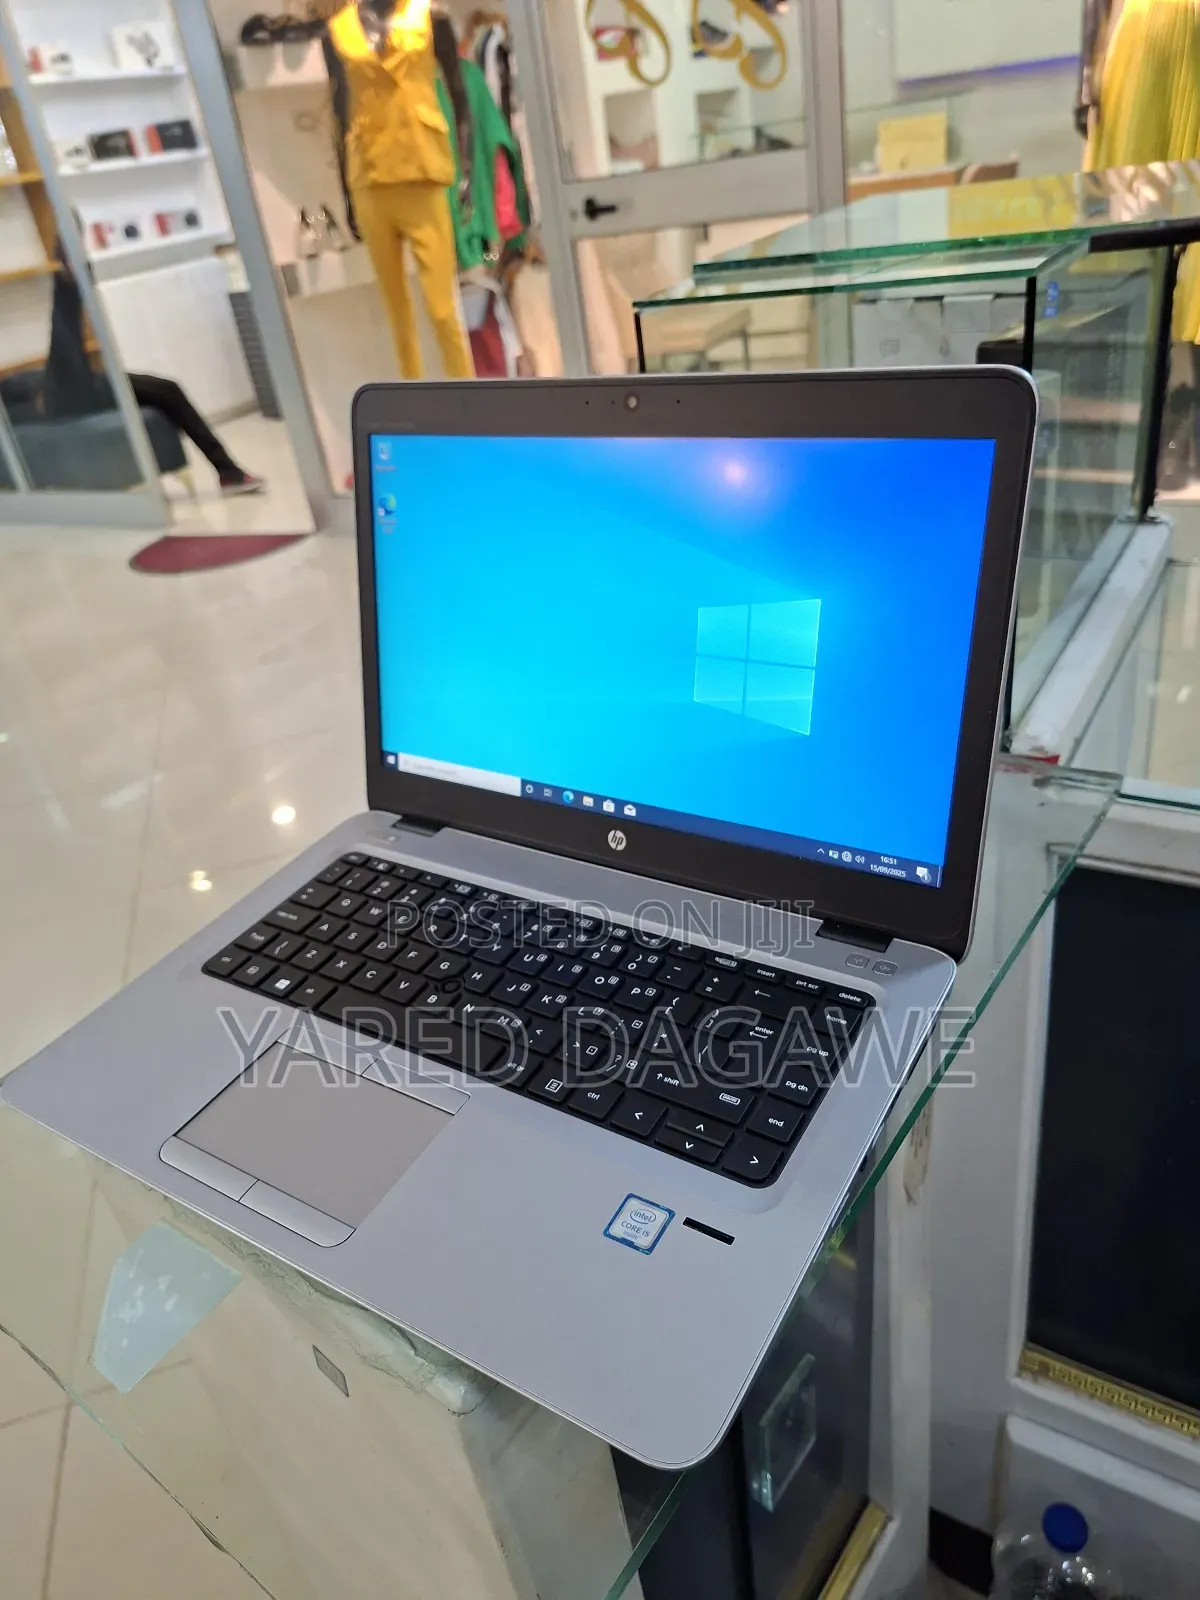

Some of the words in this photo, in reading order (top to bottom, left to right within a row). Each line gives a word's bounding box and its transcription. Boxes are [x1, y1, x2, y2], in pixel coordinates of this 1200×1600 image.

[609, 830, 625, 850] hp
[880, 855, 897, 865] 16:51
[870, 864, 906, 878] 15/09/2025
[319, 923, 329, 932] A
[348, 932, 358, 940] S
[377, 941, 388, 949] D
[524, 953, 534, 962] U
[591, 951, 600, 960] 9
[335, 960, 347, 968] X
[440, 961, 450, 970] G
[366, 970, 377, 978] C
[471, 972, 482, 980] H
[756, 968, 776, 978] insert
[399, 981, 410, 989] V
[795, 979, 808, 988] prt
[808, 982, 819, 990] scr
[631, 987, 641, 995] P
[427, 995, 438, 1003] B
[541, 995, 552, 1004] K
[839, 992, 862, 1002] delete
[462, 1004, 475, 1012] N
[578, 1007, 584, 1015] L
[497, 1016, 509, 1025] M
[826, 1014, 847, 1025] home
[754, 1025, 775, 1036] enter
[806, 1046, 818, 1054] pg
[818, 1049, 829, 1057] up
[663, 1076, 680, 1086] shift
[785, 1080, 796, 1088] pg
[797, 1084, 809, 1092] dn
[587, 1091, 600, 1100] ctrl
[768, 1116, 785, 1127] end
[633, 1209, 652, 1222] intel
[621, 1220, 642, 1234] CORE
